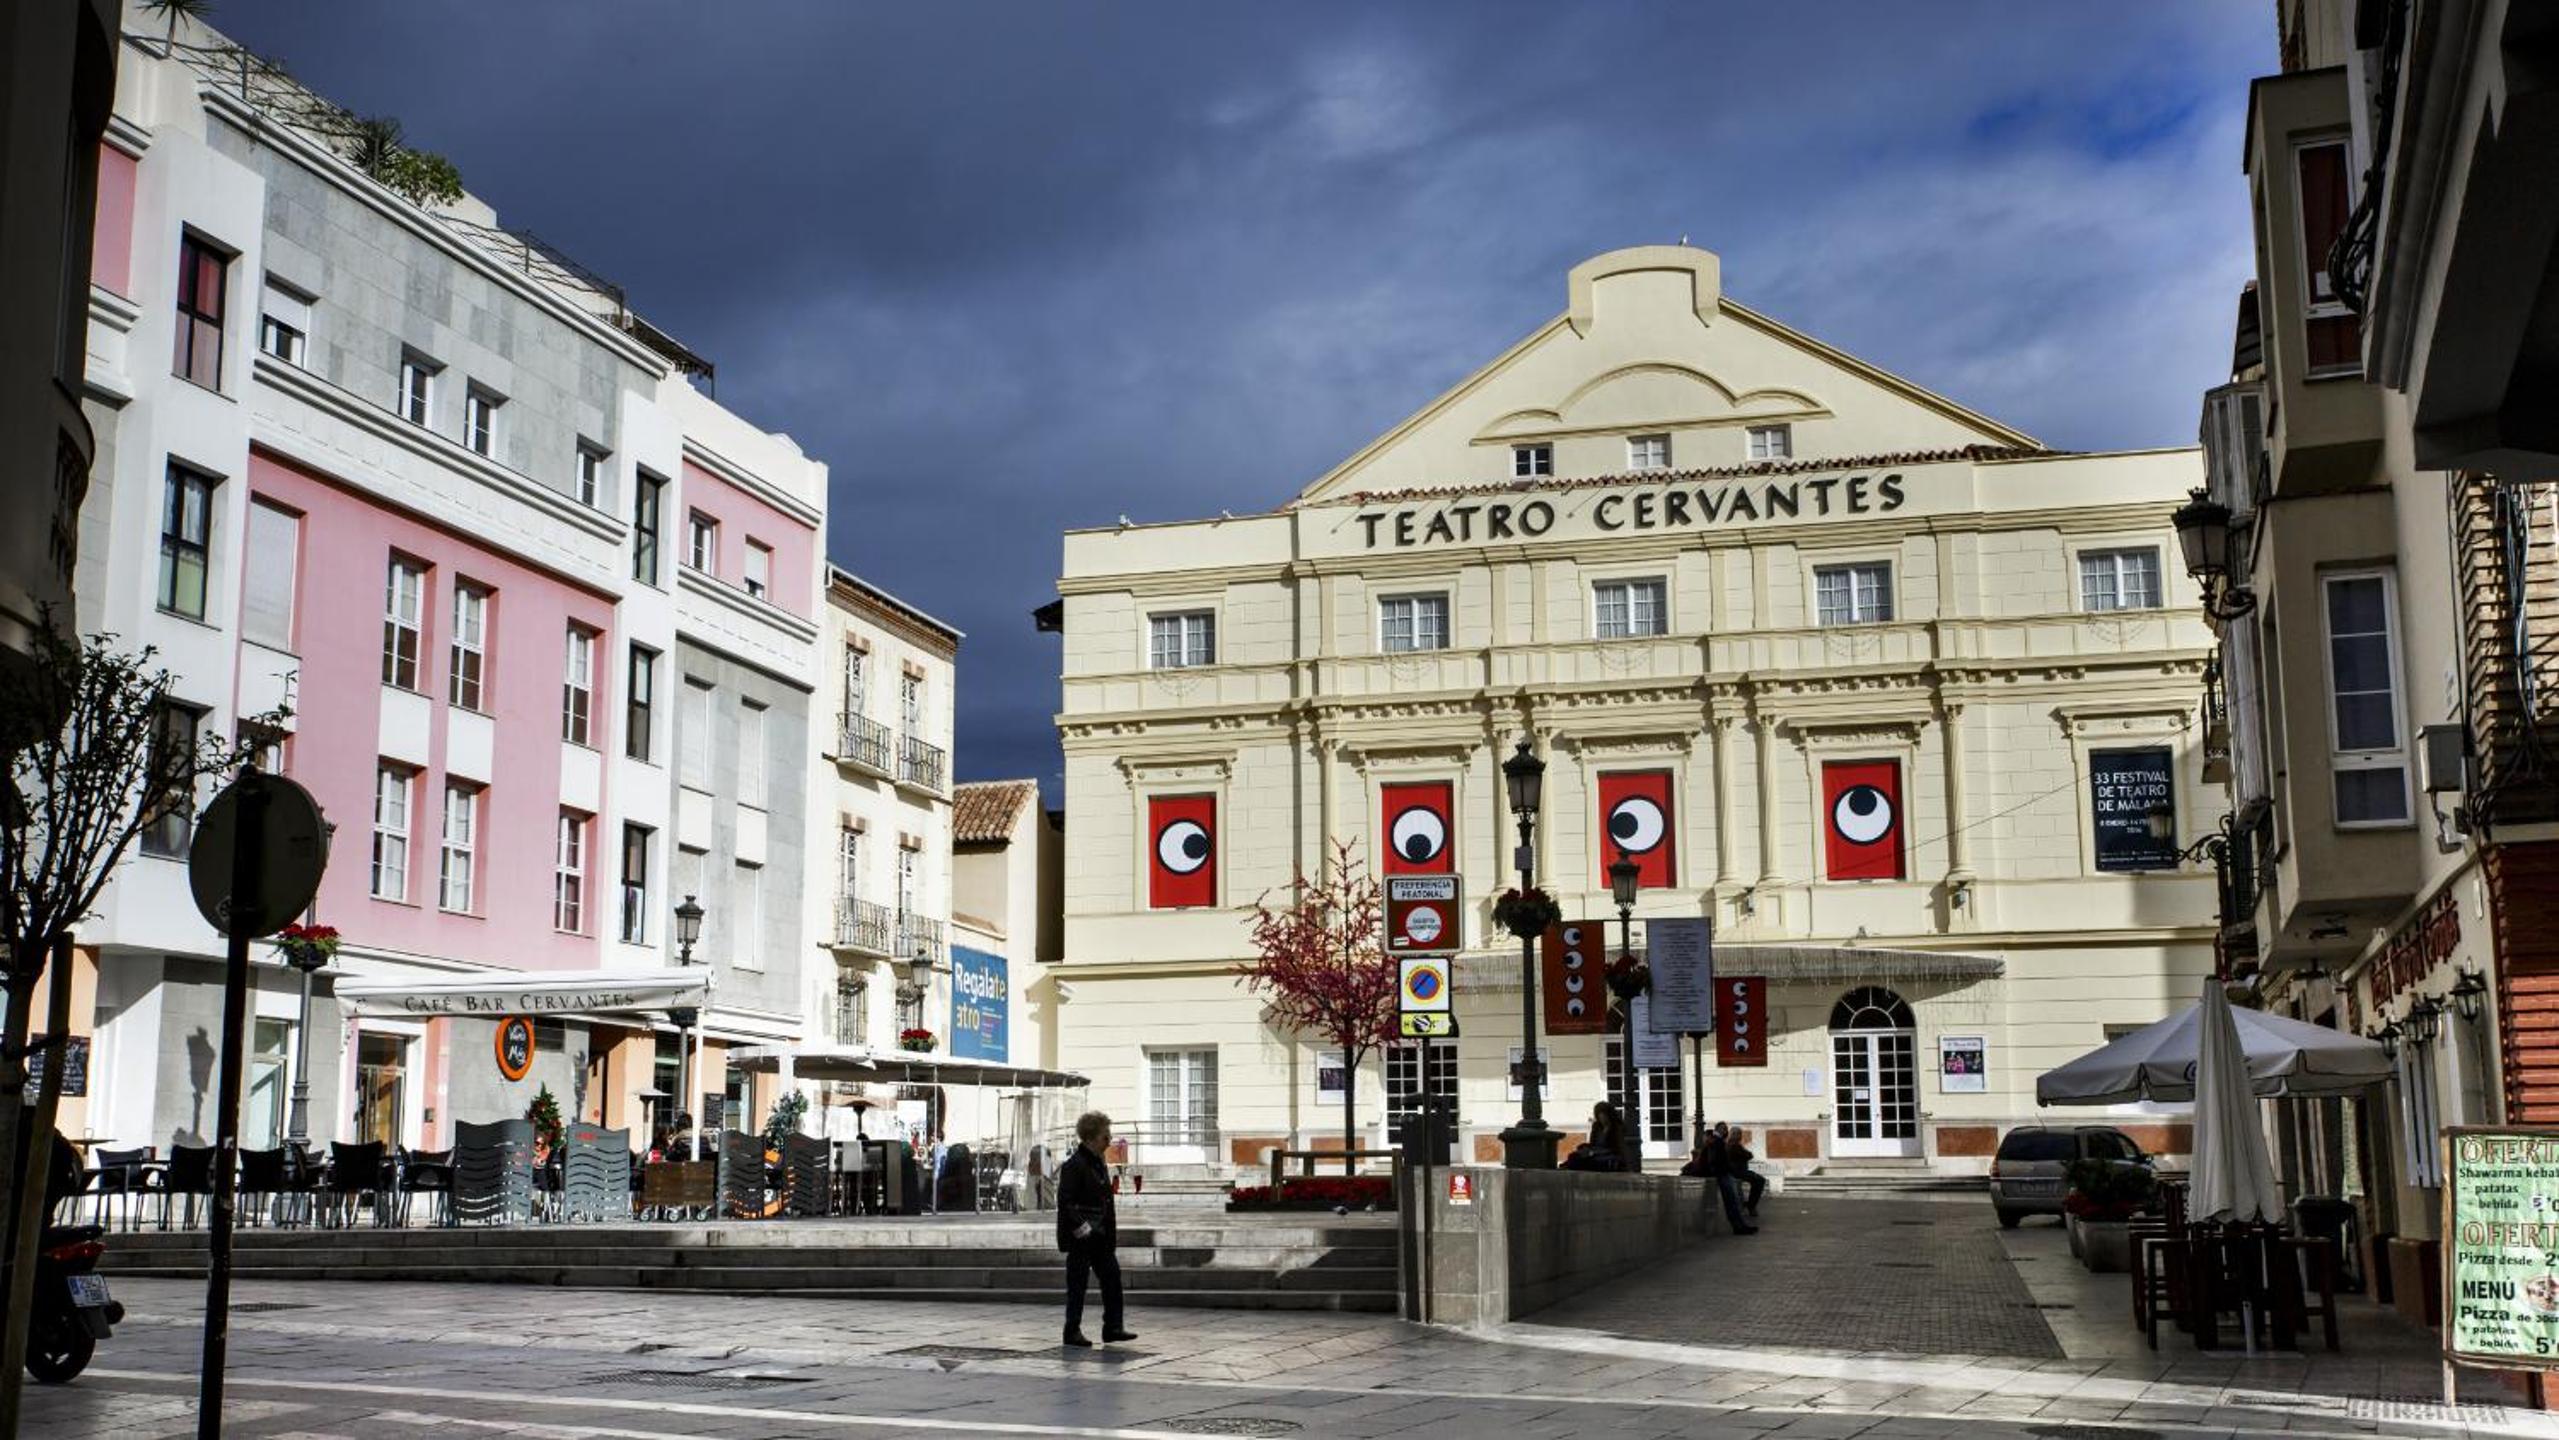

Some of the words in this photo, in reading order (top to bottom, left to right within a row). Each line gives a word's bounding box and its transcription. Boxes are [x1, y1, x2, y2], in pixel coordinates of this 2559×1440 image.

[1356, 500, 1556, 548] TEATRO
[1594, 473, 1906, 532] CERVANTES
[2094, 772, 2110, 784] 33
[2113, 770, 2169, 784] FESTIVAL
[2097, 786, 2115, 798] DE
[2117, 784, 2166, 797] TEATRO
[2097, 799, 2115, 812] DE
[1401, 889, 1444, 899] PEATONAL
[405, 995, 454, 1012] CAFÉ
[464, 995, 505, 1011] BAR
[519, 993, 635, 1010] CERVANTES
[956, 1001, 980, 1031] atro
[2461, 1138, 2559, 1164] OFERT
[2459, 1167, 2522, 1178] Shawarma
[2475, 1184, 2519, 1196] patatas
[2479, 1198, 2519, 1209] bebida
[2458, 1252, 2495, 1265] Pizza
[2499, 1255, 2532, 1266] desde
[2461, 1306, 2510, 1321] Pizza
[2517, 1313, 2531, 1322] de
[2473, 1325, 2516, 1334] patatas
